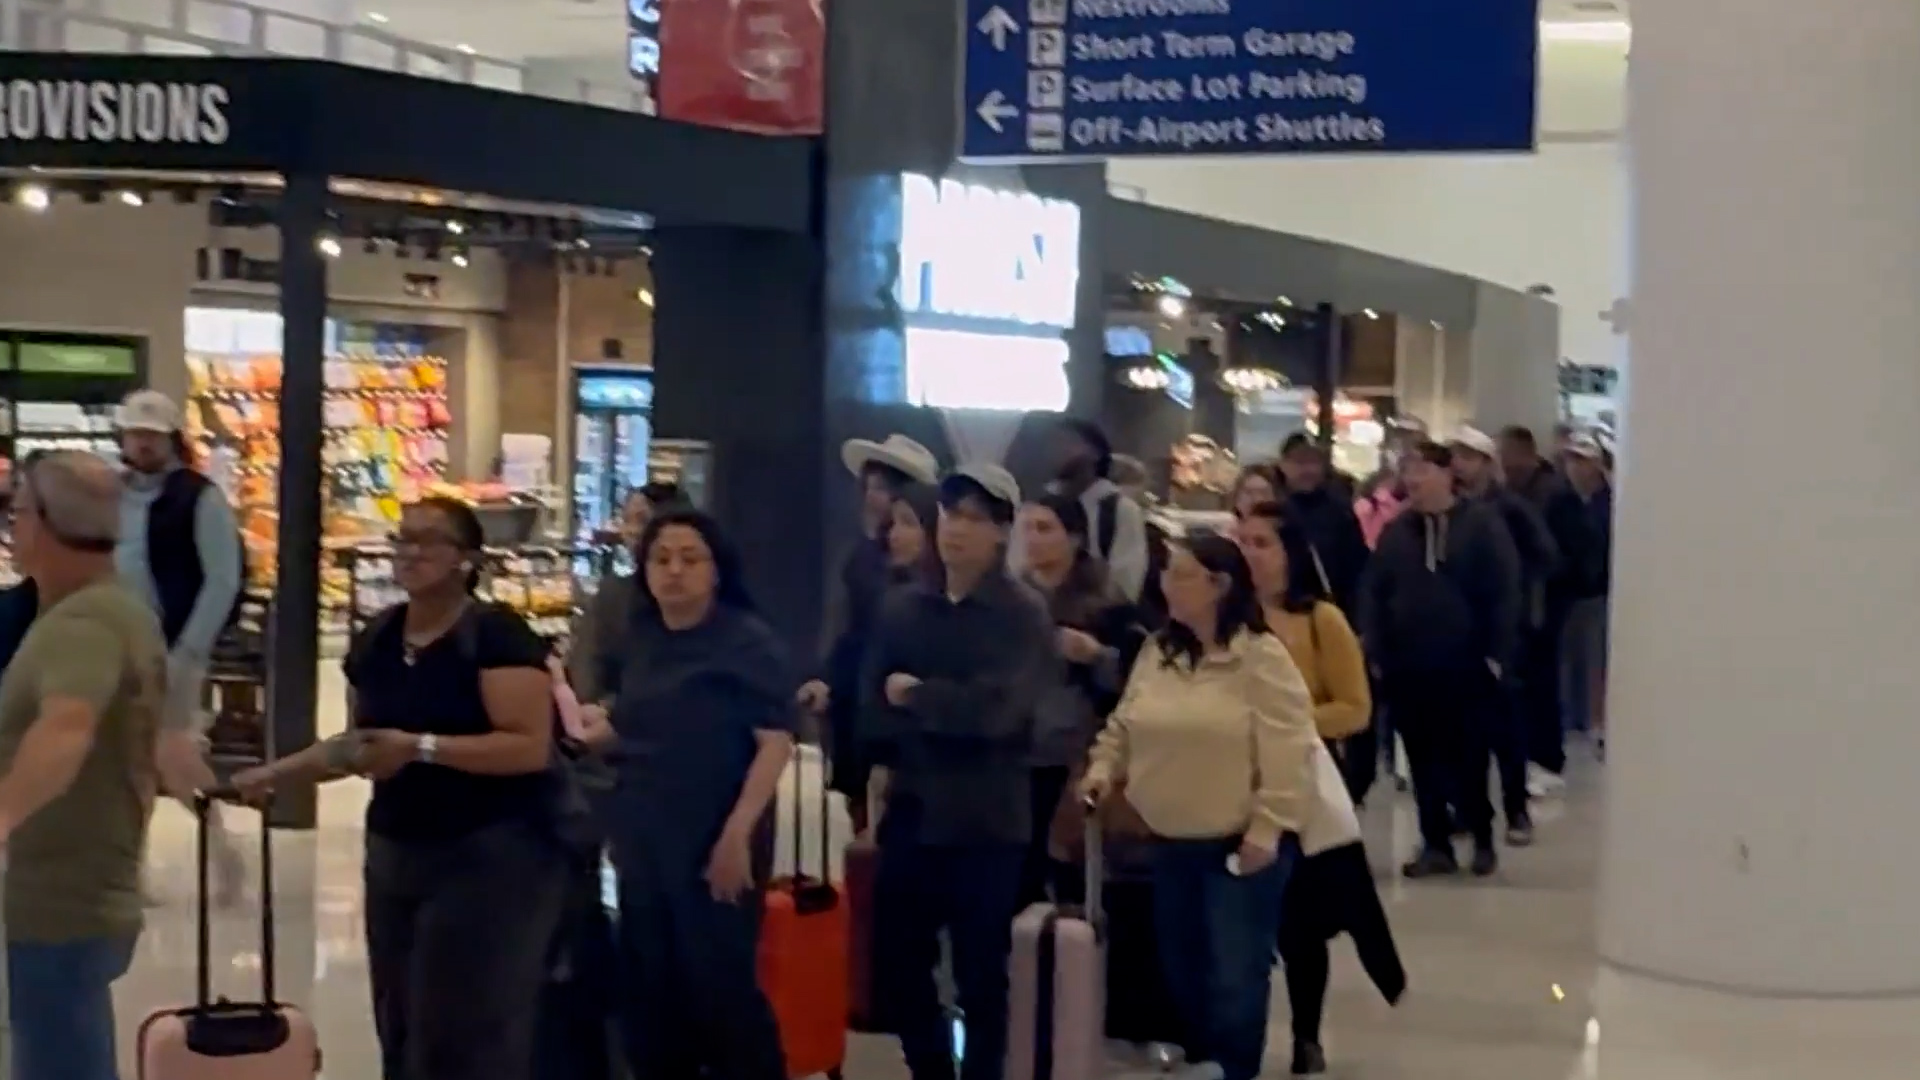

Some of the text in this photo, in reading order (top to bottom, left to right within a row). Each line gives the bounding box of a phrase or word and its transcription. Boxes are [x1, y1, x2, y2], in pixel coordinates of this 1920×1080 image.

[1072, 33, 1155, 61] Short
[1162, 31, 1236, 58] Term
[1243, 27, 1355, 62] Garage
[1070, 73, 1185, 102] Surface
[1190, 73, 1242, 101] Lot
[1248, 69, 1367, 104] Parking
[1070, 112, 1385, 148] Off-Airport Shuttles
